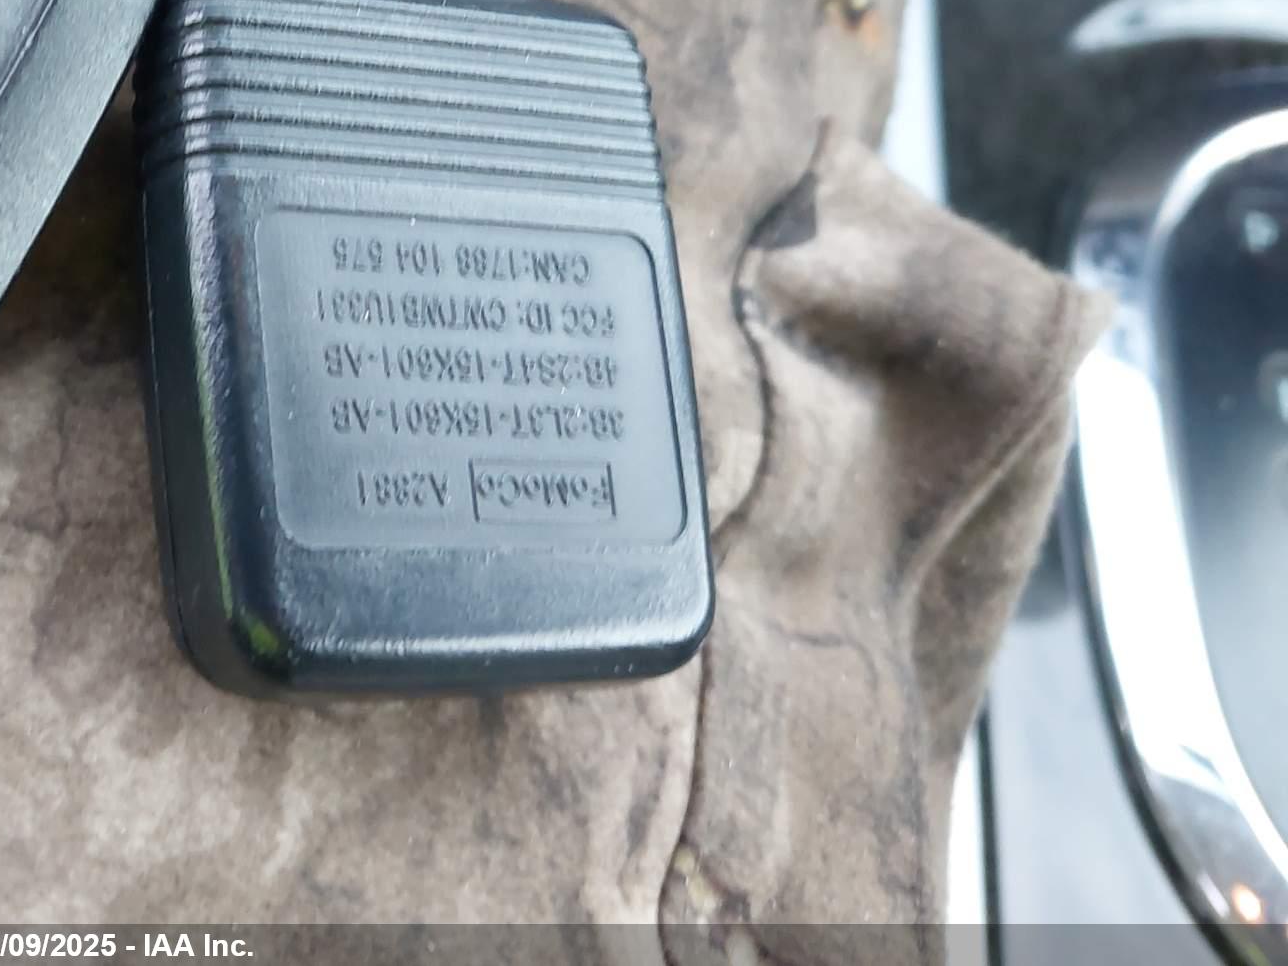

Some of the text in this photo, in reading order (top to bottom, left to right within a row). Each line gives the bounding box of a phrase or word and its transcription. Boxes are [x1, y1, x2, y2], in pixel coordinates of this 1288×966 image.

[331, 236, 384, 274] 575
[395, 240, 441, 276] 104
[314, 289, 616, 338] FCC ID: CWTWB1U331
[474, 472, 614, 510] FoMoCo
